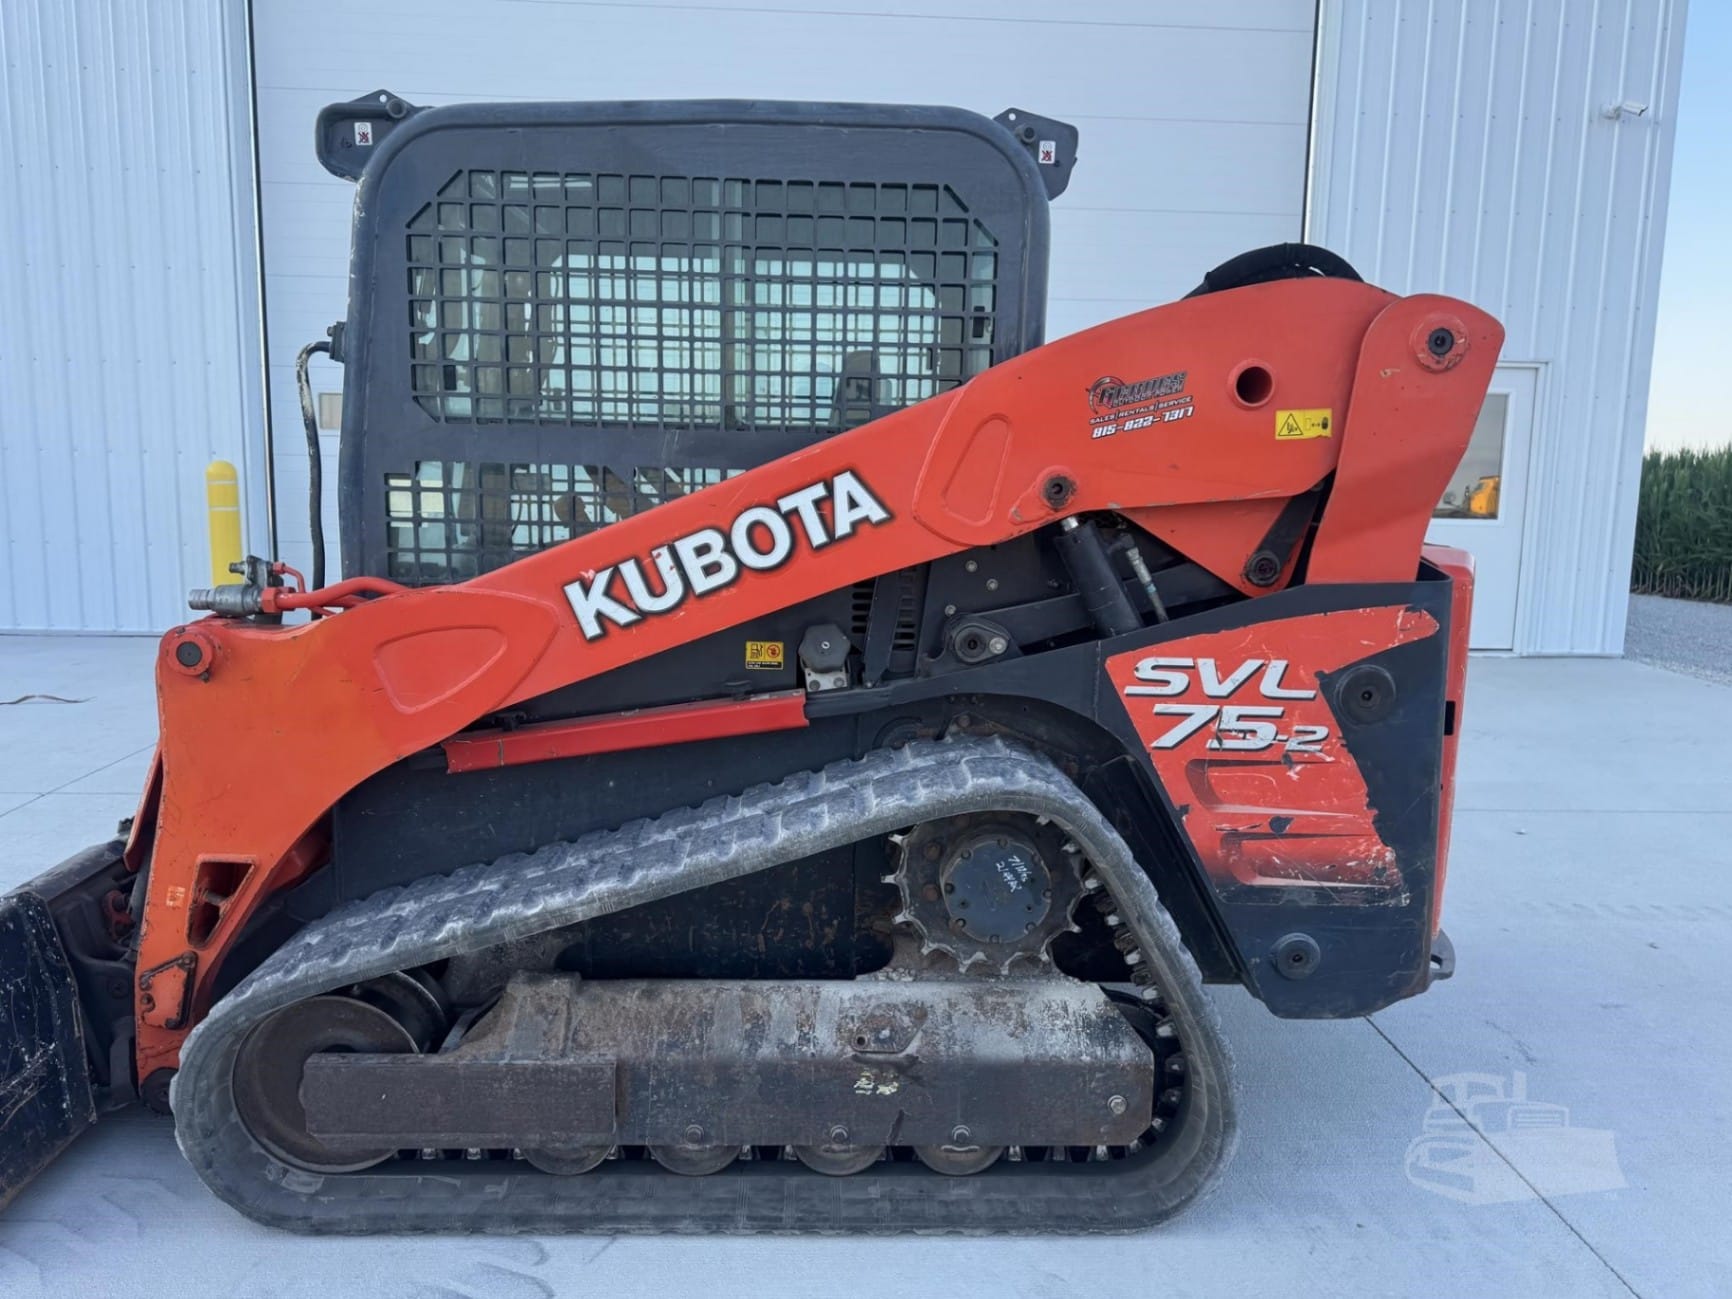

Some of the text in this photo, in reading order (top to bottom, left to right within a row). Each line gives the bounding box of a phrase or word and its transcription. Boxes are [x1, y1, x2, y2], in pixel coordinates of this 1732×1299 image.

[1089, 395, 1193, 425] SALES RENTALS SERVICE
[563, 470, 892, 640] KUBOTA
[1124, 657, 1317, 699] SVL
[1151, 704, 1330, 752] 75-2
